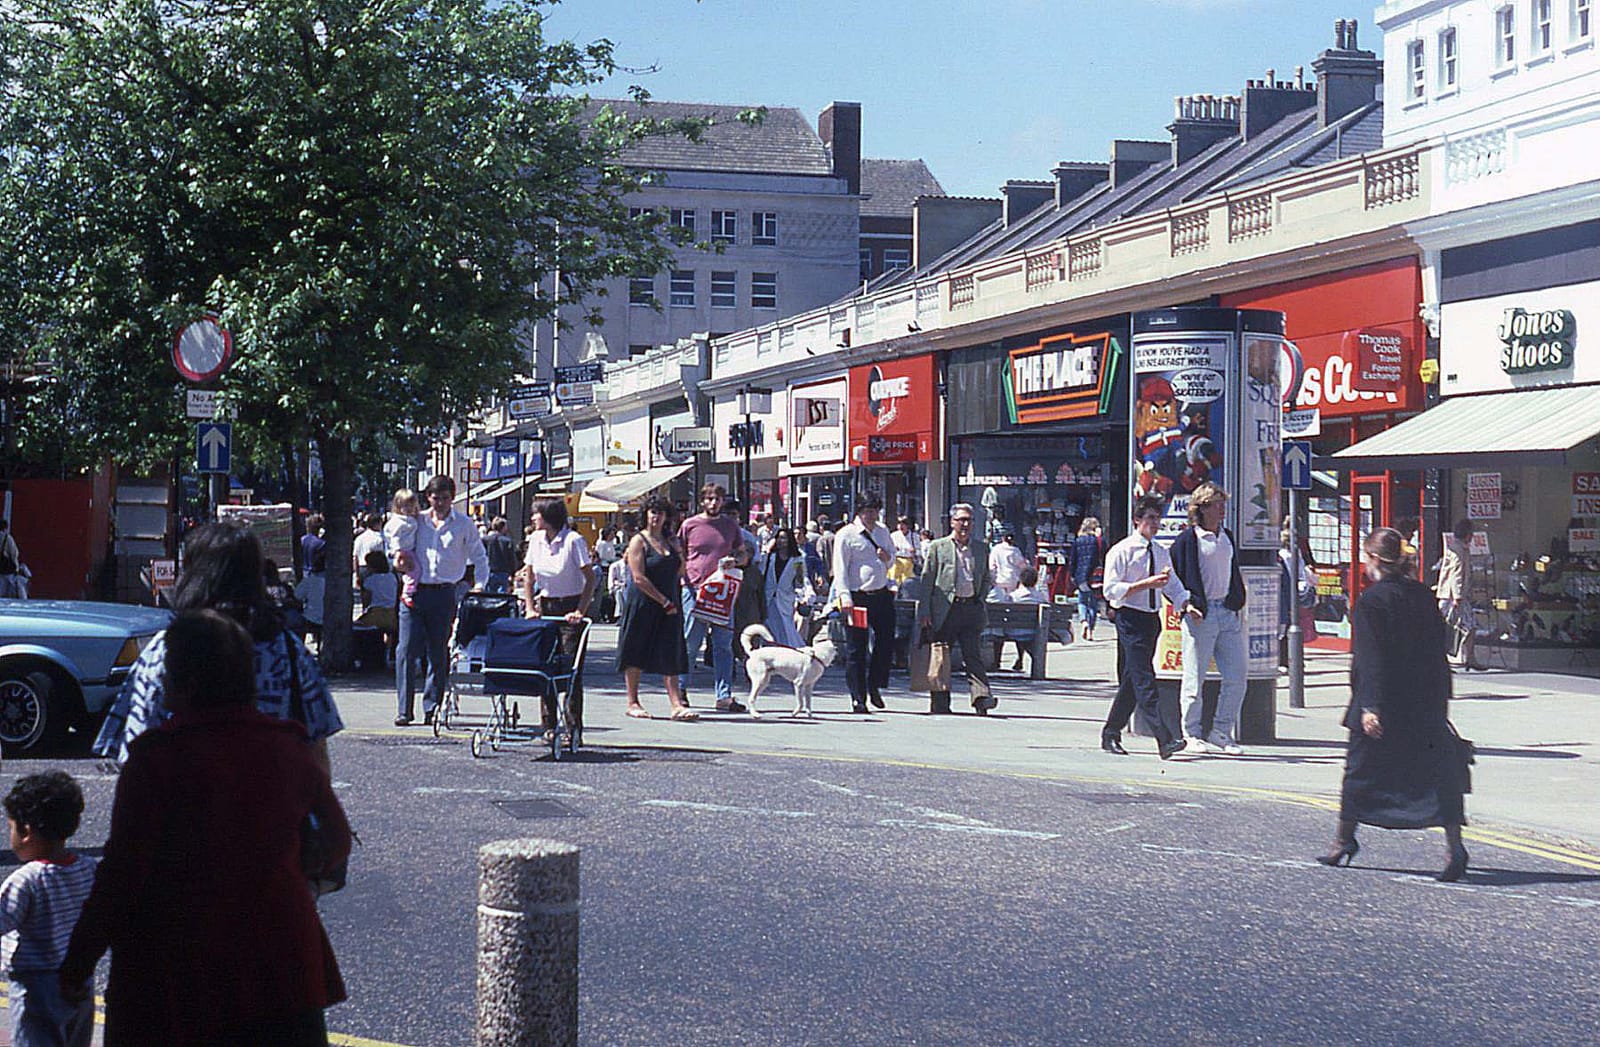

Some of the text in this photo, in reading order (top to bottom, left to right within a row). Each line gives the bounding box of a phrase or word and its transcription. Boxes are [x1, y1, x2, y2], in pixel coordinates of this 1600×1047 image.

[1499, 308, 1564, 339] Jones
[1360, 334, 1401, 344] Thomas
[1184, 346, 1201, 355] HAD
[1202, 346, 1209, 355] A
[1373, 344, 1401, 353] Cook
[1379, 354, 1401, 362] Travel
[1500, 339, 1562, 369] shoes
[1014, 346, 1097, 394] THE PLACE
[1372, 364, 1401, 373] Foreign
[1362, 371, 1401, 381] Exchange
[1175, 388, 1206, 397] SKATES
[678, 439, 710, 449] BURTON
[892, 440, 915, 448] PRICE
[1470, 503, 1499, 517] SALE
[1572, 530, 1595, 541] SALE
